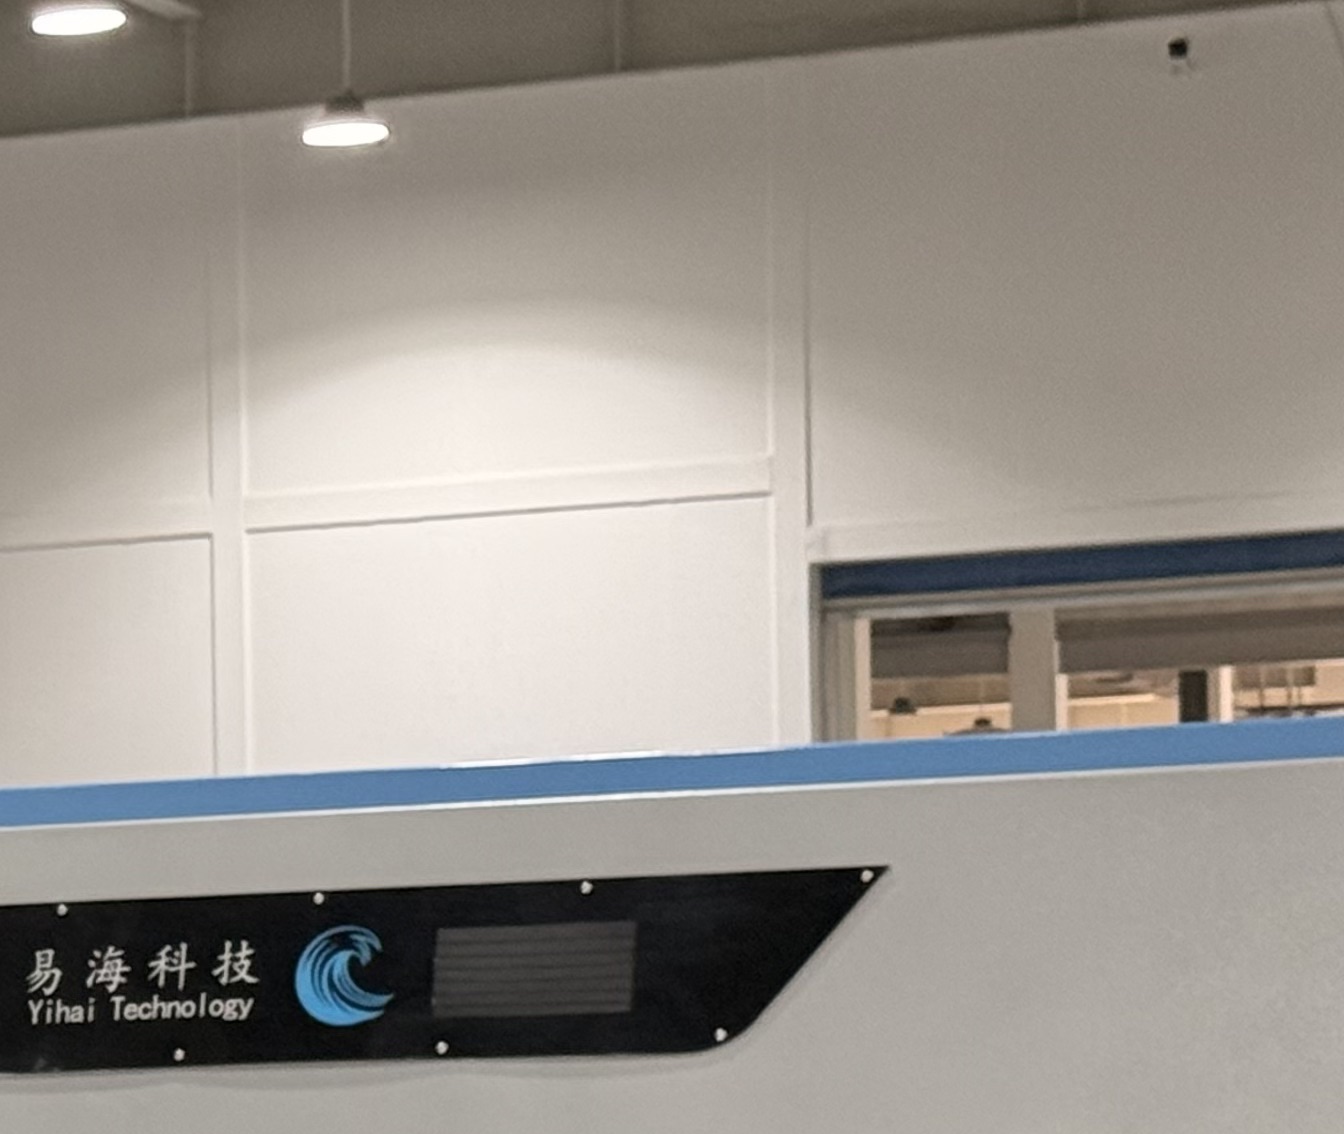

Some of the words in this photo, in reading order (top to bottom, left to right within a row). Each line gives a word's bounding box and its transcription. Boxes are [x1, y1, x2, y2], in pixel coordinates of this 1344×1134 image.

[26, 939, 260, 996] 易海科技
[28, 997, 96, 1025] Yihai
[111, 992, 255, 1021] Technology
